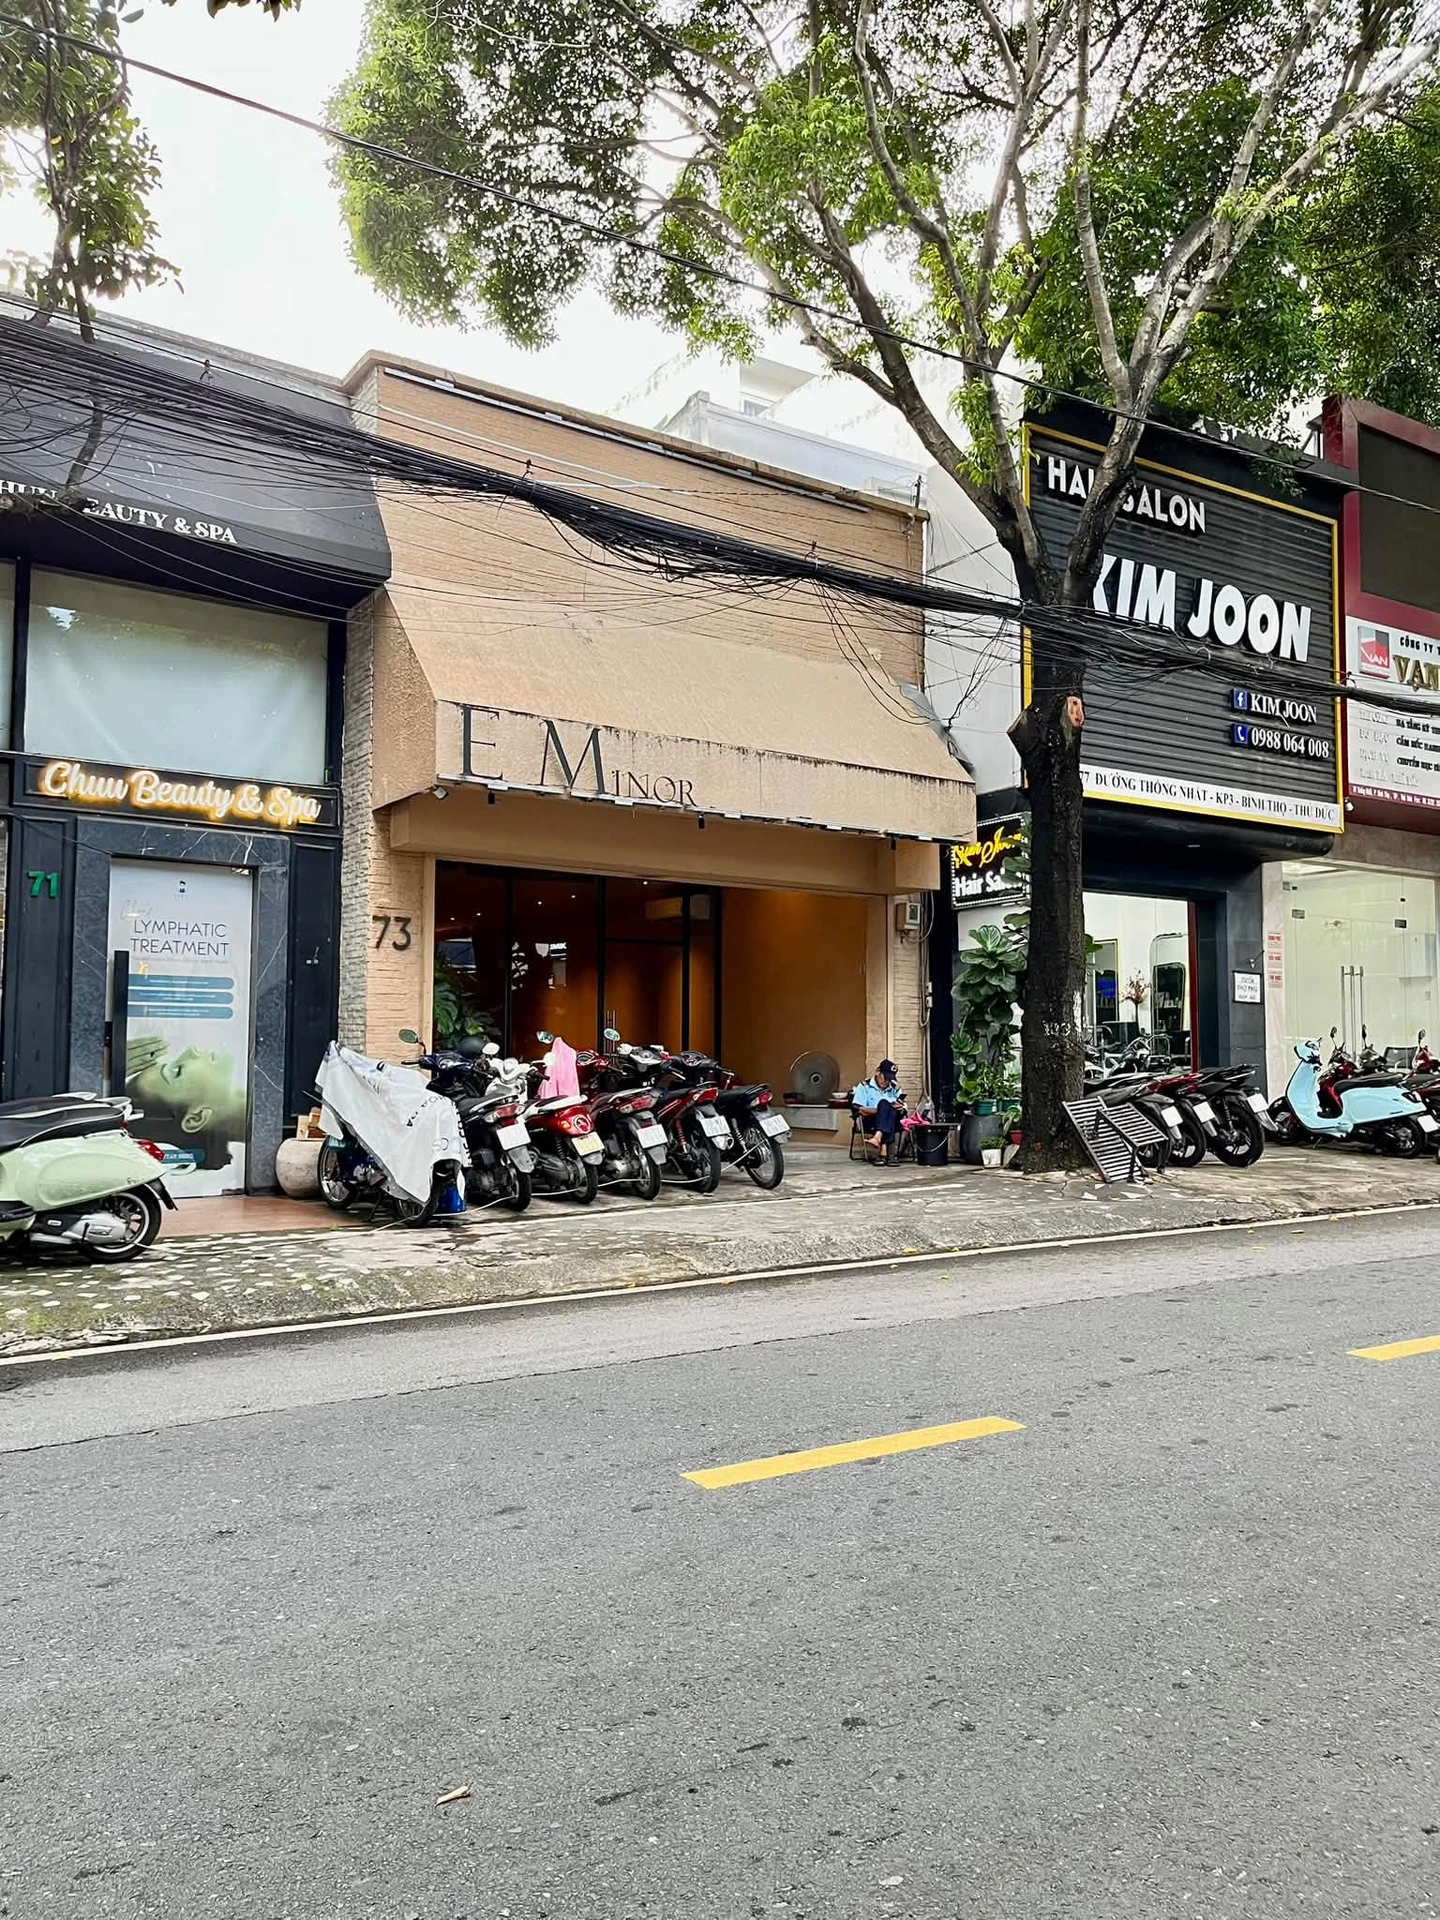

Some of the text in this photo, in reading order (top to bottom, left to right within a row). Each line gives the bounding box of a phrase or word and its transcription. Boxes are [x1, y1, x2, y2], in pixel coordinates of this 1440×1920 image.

[1048, 456, 1095, 499] HAI
[82, 498, 168, 529] EAUTY
[173, 516, 191, 535] &
[194, 521, 238, 544] SPA
[1093, 554, 1312, 662] KIM JOON
[1424, 642, 1434, 653] TY
[1250, 693, 1281, 716] KIM
[1283, 700, 1317, 723] JOON
[460, 702, 504, 780] E
[1251, 727, 1329, 758] 0988 064 008
[44, 761, 321, 826] Chuu Beauty & Spa
[28, 871, 60, 899] 71
[954, 872, 984, 897] Hair
[133, 919, 227, 938] LYMPHATIC
[372, 914, 413, 951] 73
[130, 937, 230, 957] TREATMENT
